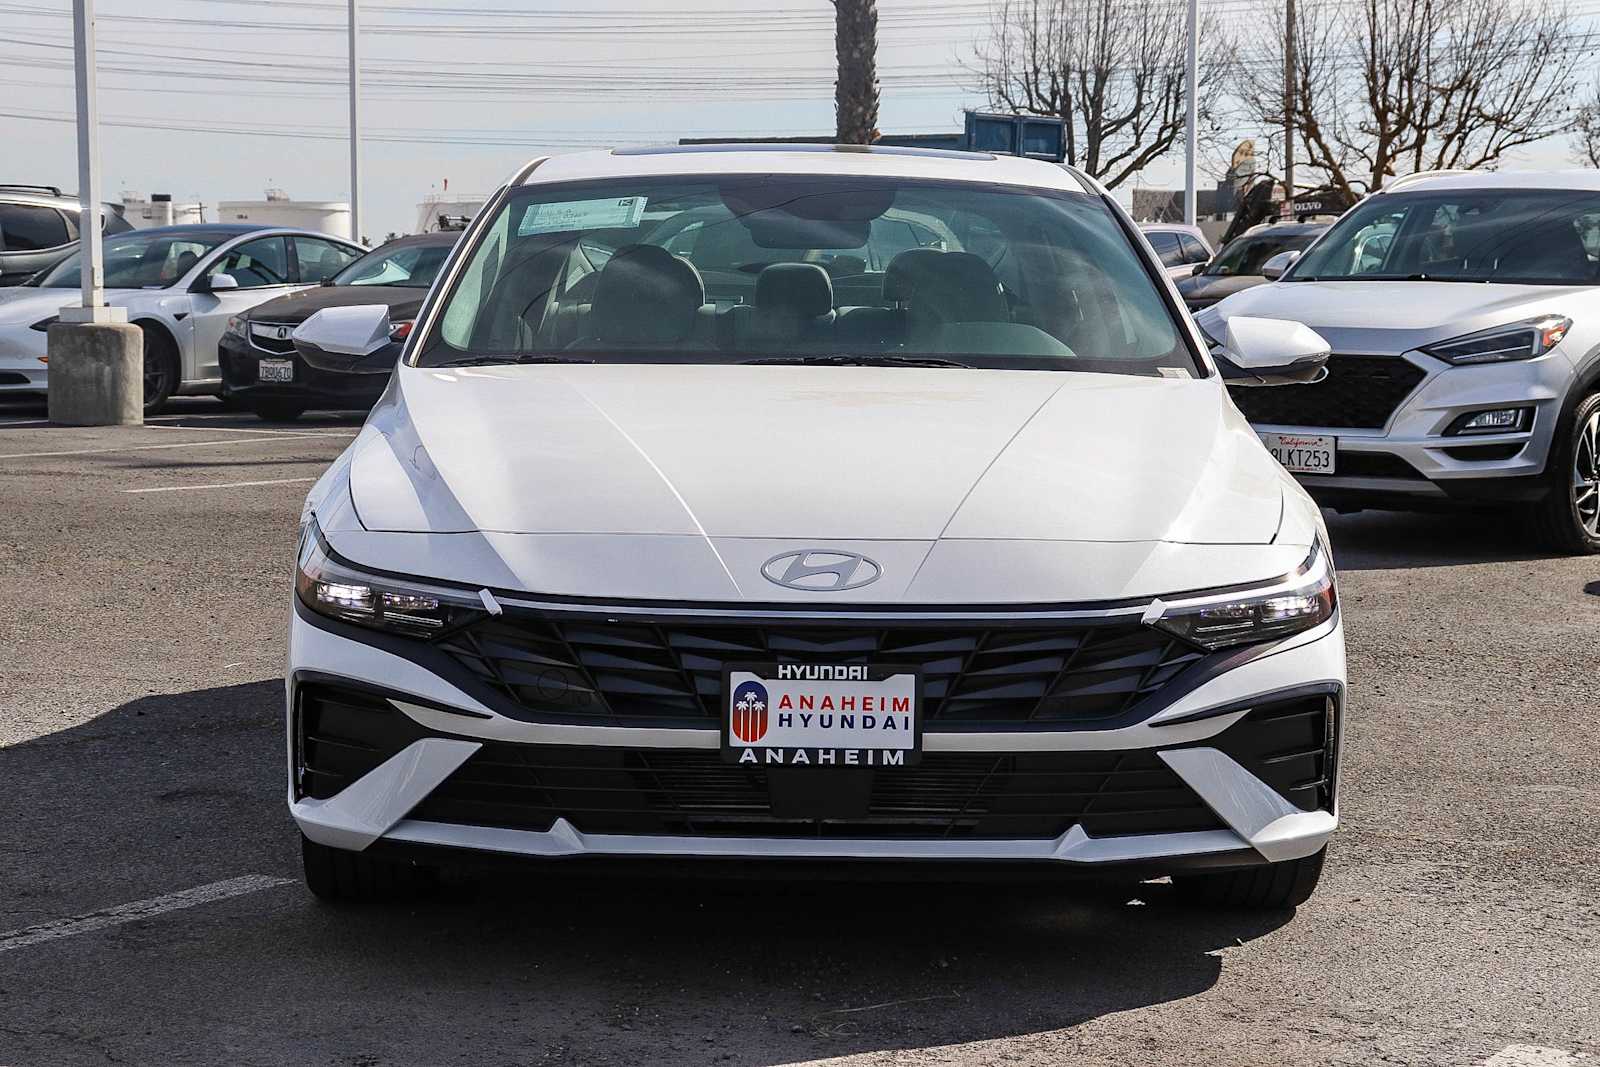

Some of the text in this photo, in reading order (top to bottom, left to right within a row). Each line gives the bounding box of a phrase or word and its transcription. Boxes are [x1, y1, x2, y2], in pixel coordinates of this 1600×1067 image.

[1294, 201, 1322, 211] OLVO
[1280, 436, 1319, 447] California
[777, 664, 868, 680] HYUNDAI
[778, 694, 910, 712] ANAHEIM
[778, 713, 909, 730] HYUNDAI
[738, 748, 904, 765] ANAHEIM
